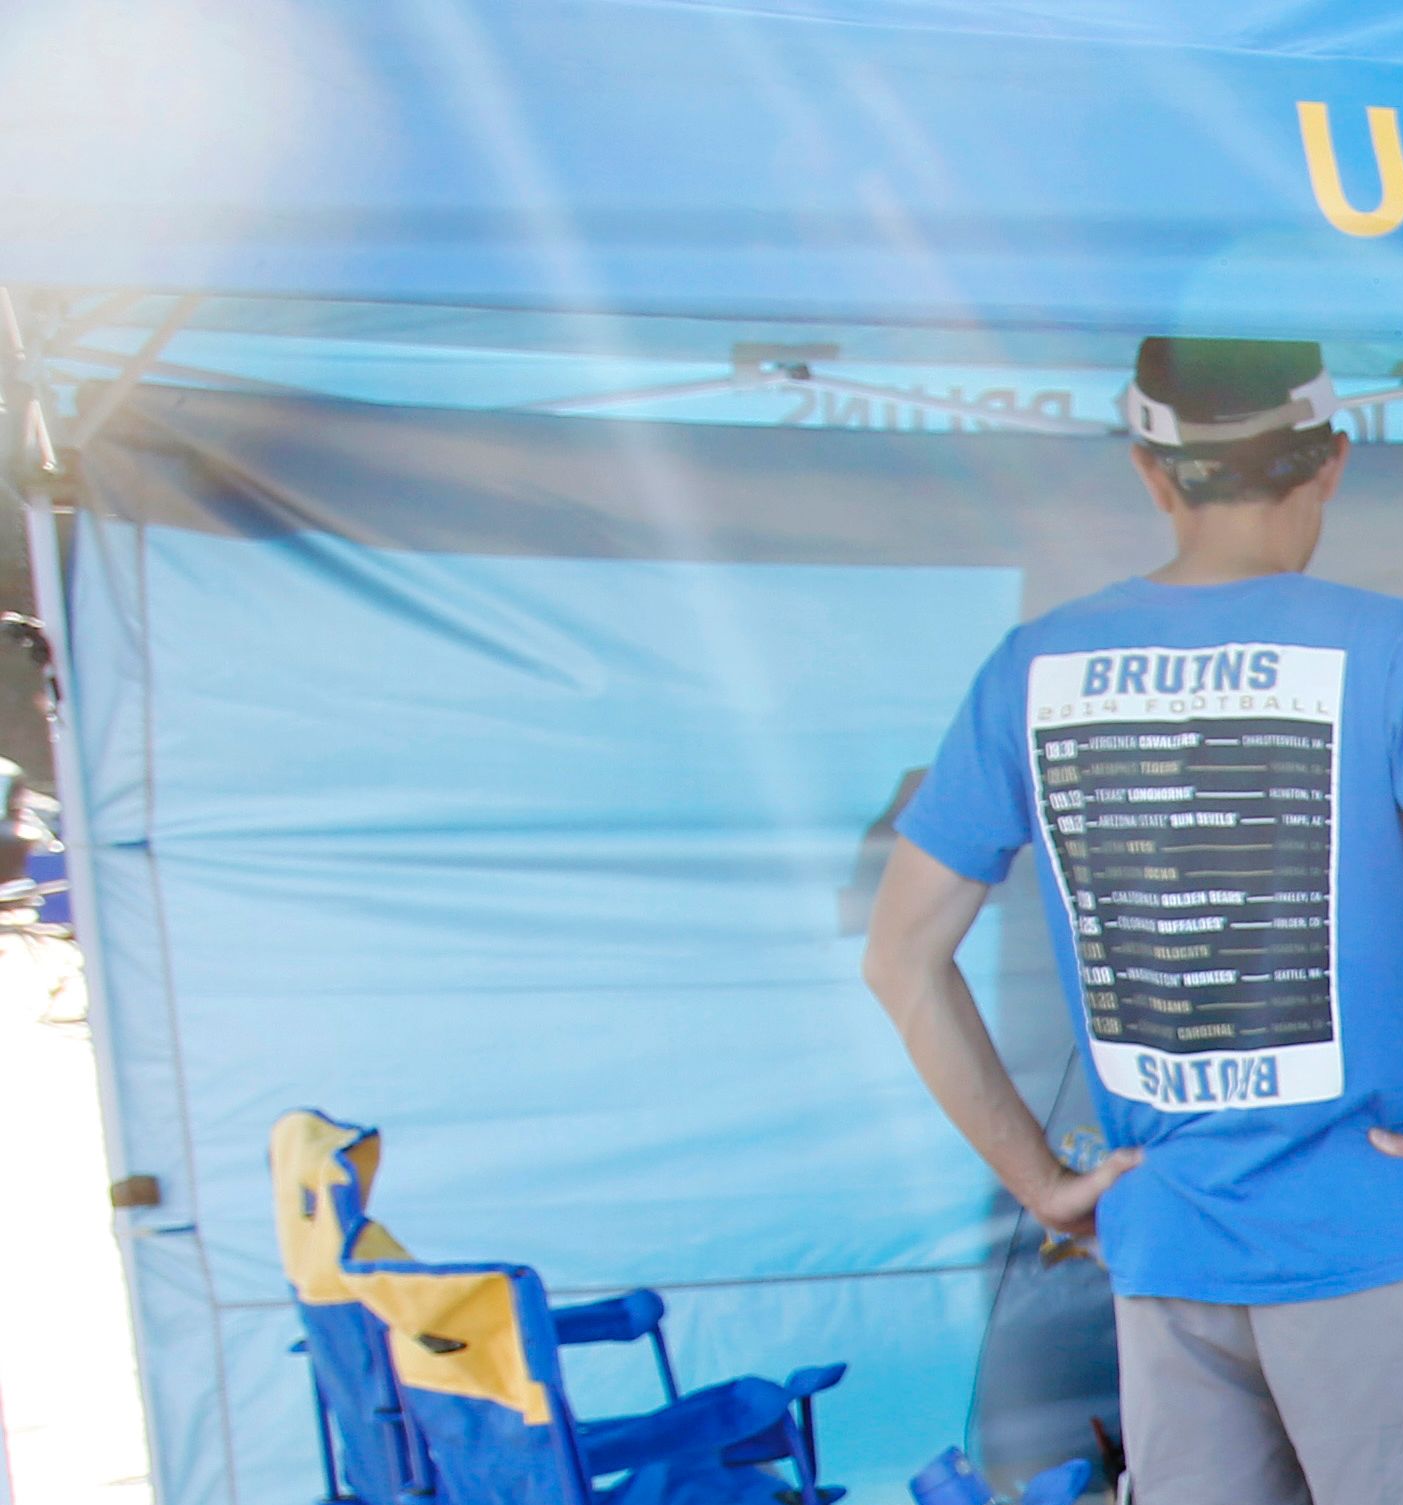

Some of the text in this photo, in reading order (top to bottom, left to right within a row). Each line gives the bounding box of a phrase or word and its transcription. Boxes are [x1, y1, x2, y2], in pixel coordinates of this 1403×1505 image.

[1082, 650, 1280, 696] BRUINS
[1037, 695, 1330, 721] 2014 FOOTBALL
[1127, 786, 1195, 803] LONGHORNS
[1169, 813, 1195, 830] SUN
[1182, 970, 1239, 988] HUSKIES
